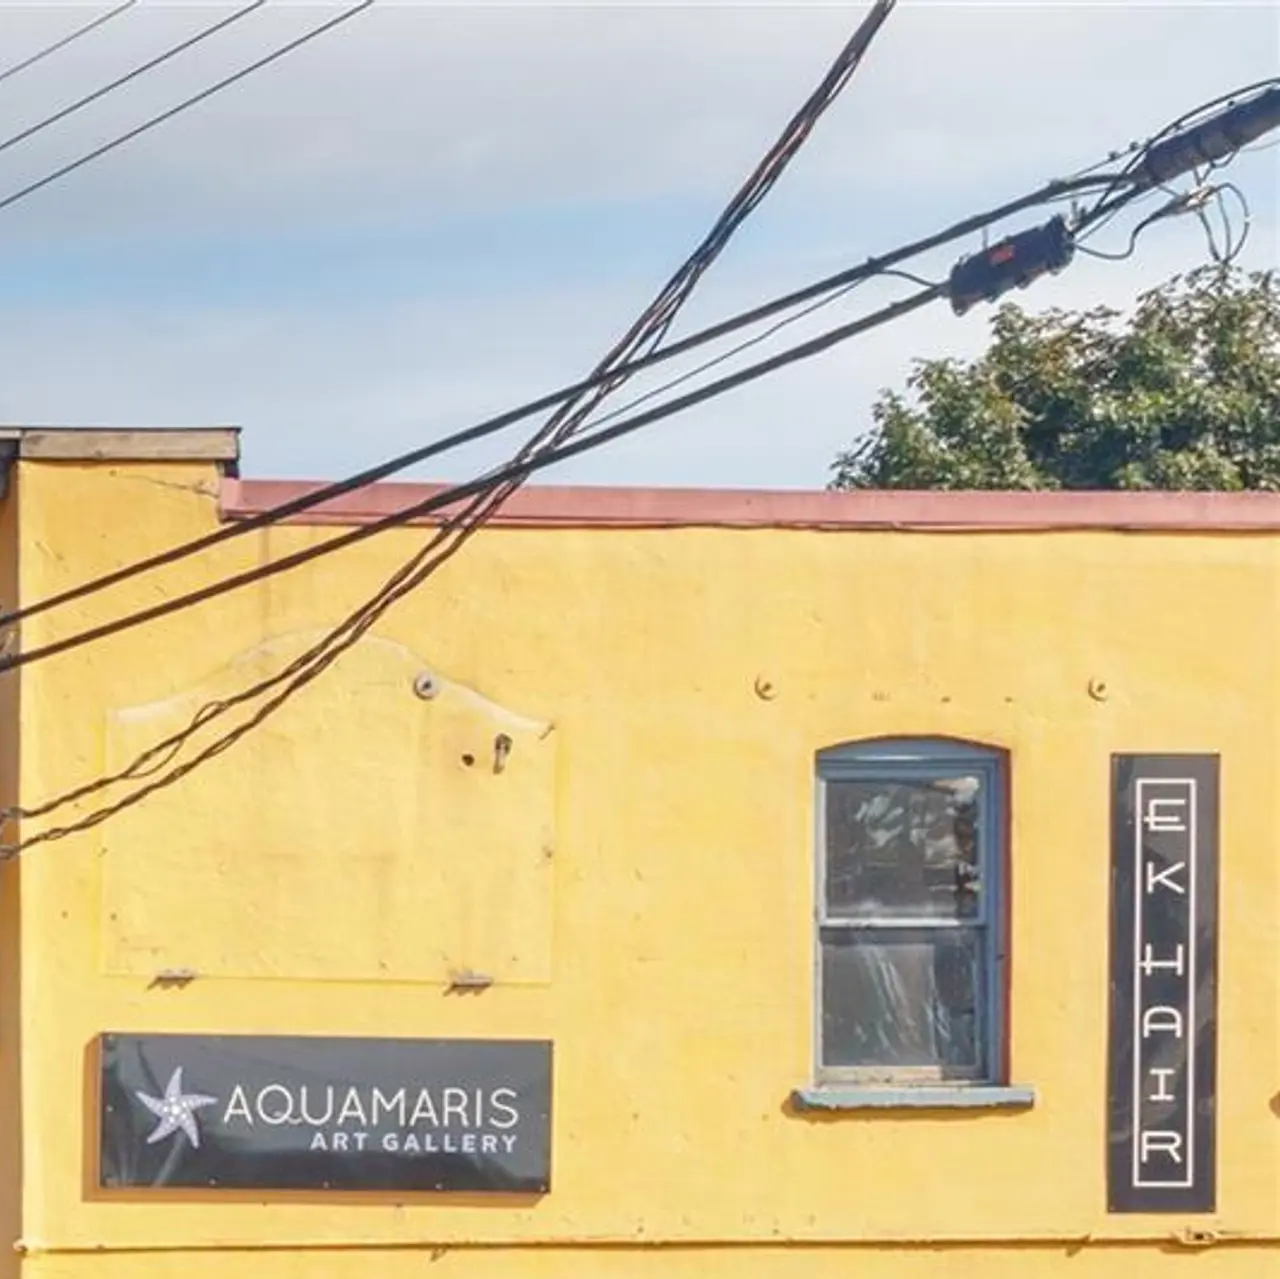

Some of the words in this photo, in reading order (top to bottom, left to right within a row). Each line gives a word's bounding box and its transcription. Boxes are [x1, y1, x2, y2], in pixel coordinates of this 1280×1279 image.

[223, 1084, 519, 1129] AQUAMARIS
[309, 1132, 369, 1152] ART
[383, 1132, 518, 1154] GALLERY
